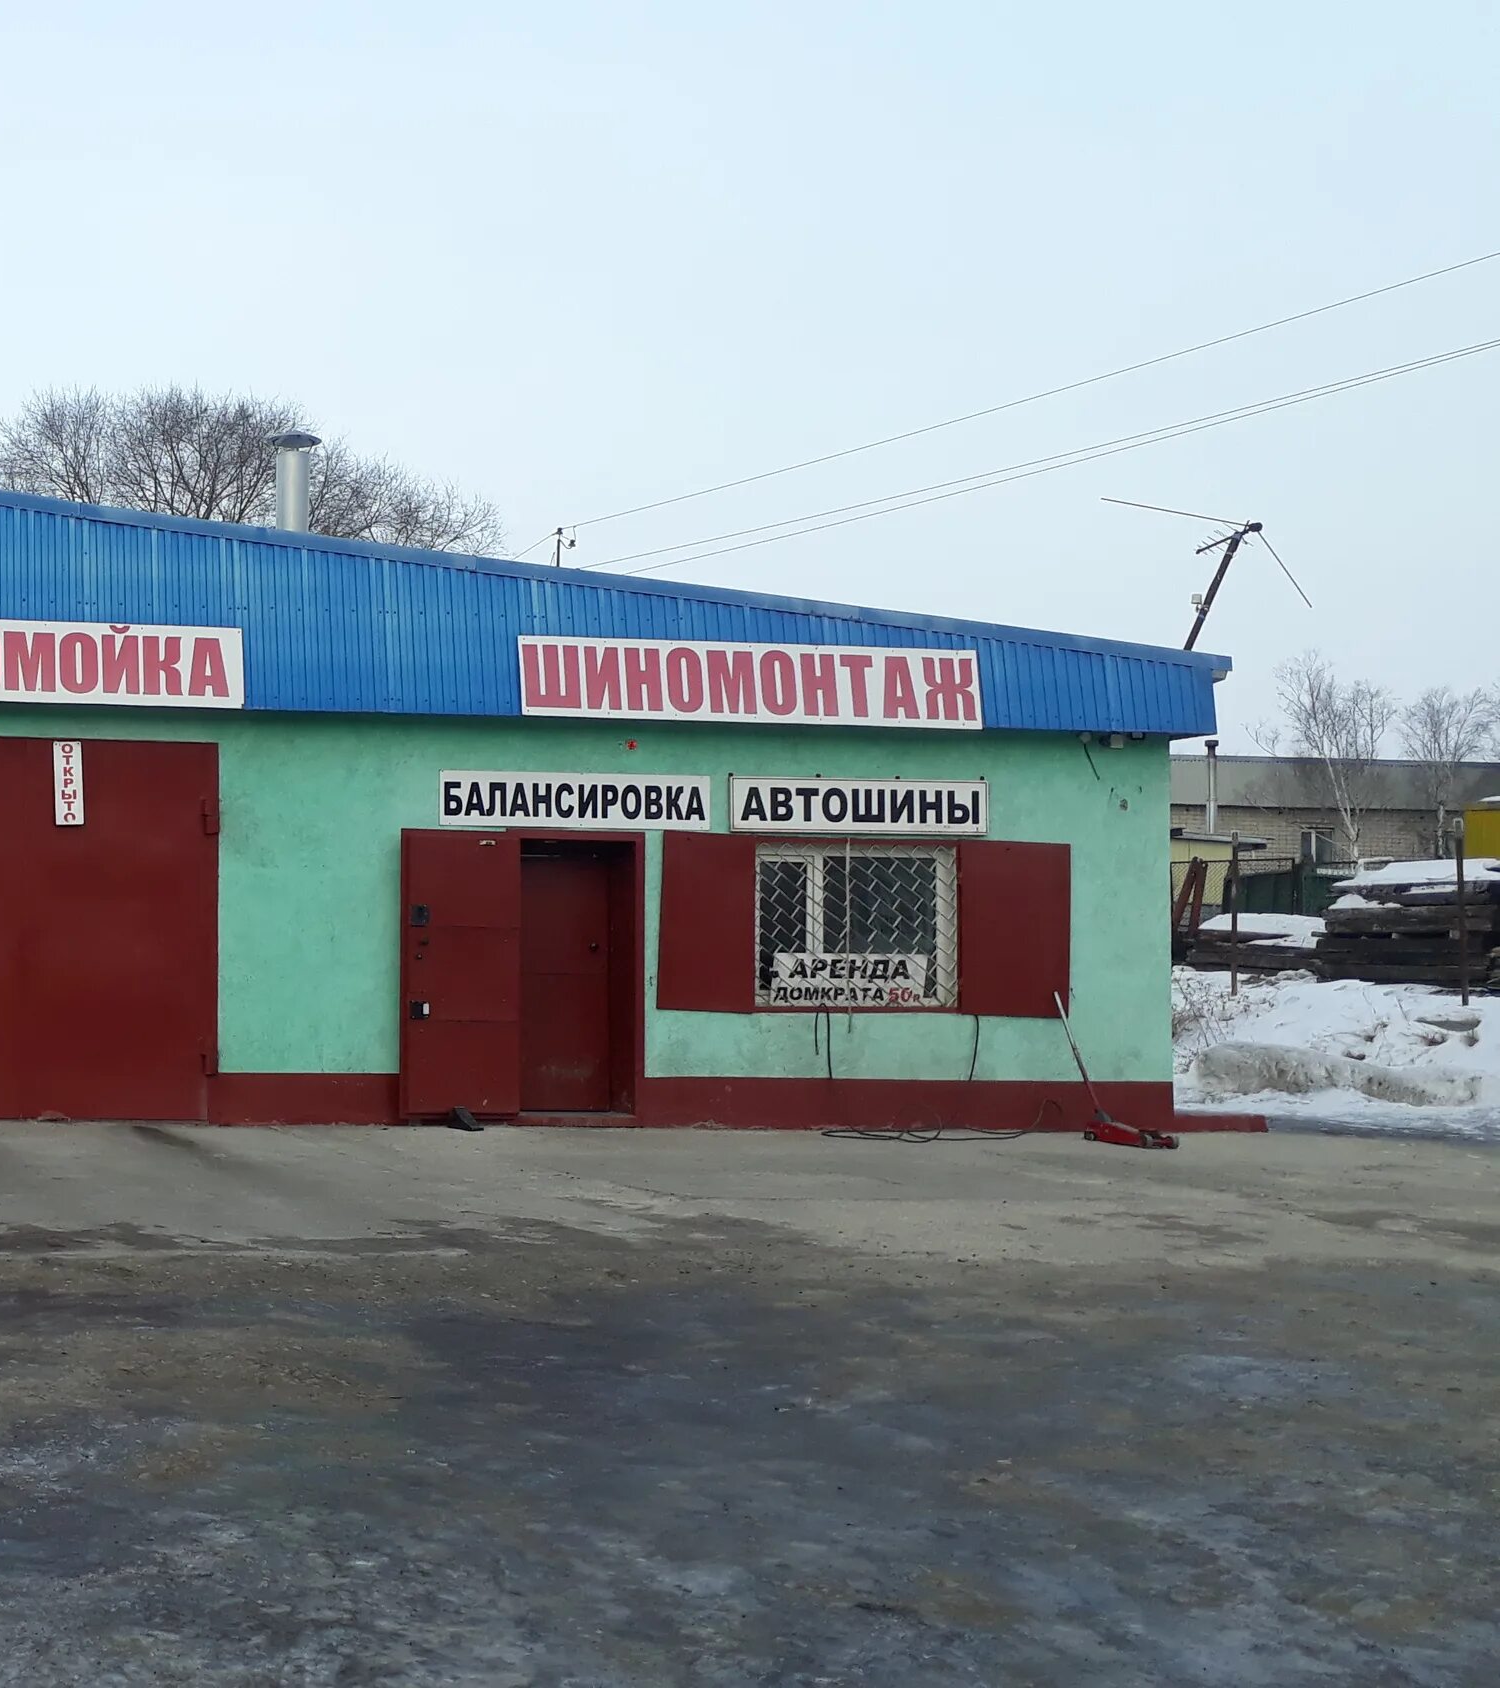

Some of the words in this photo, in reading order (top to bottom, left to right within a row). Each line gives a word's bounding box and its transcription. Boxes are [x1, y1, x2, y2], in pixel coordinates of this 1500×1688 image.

[521, 643, 979, 722] ШИНОМОНТАЖ
[61, 743, 77, 823] ОТКРЫТО
[443, 780, 706, 822] БАЛАНСИРОВКА
[740, 786, 981, 825] АВТОШИНЫ
[788, 959, 910, 983] АРЕНДА
[773, 986, 885, 1003] ДОМКРАТА
